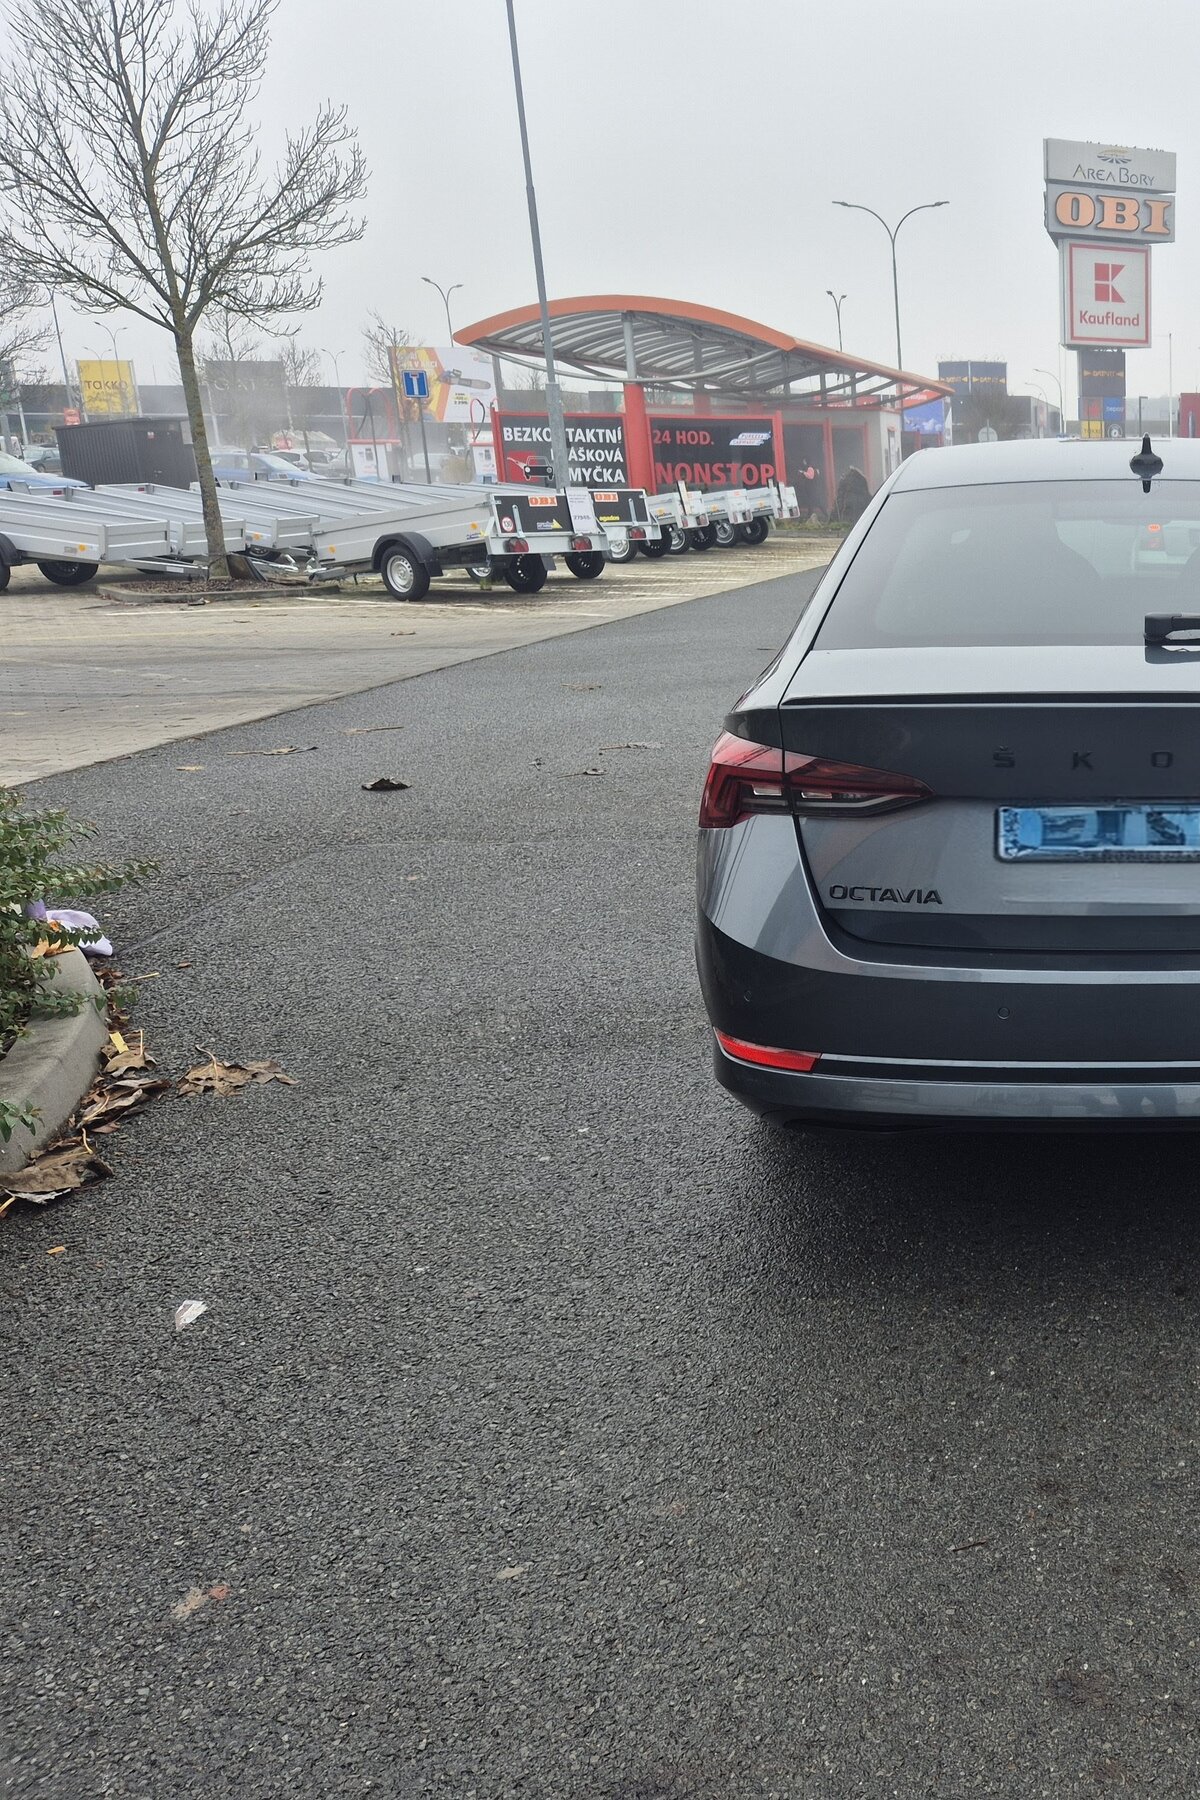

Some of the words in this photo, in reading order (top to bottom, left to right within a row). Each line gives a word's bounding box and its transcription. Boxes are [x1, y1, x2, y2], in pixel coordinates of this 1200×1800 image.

[1072, 164, 1116, 182] AREA
[1119, 167, 1155, 186] BORY
[1055, 191, 1171, 235] OBI
[1079, 310, 1140, 327] Kaufland
[503, 426, 622, 443] BEZKOTAKTNÍ
[653, 430, 671, 444] 24
[676, 430, 715, 445] HOD.
[550, 447, 624, 462] ÁŠKOVÁ
[568, 466, 625, 483] MYČKA
[655, 463, 775, 486] NONSTOP
[829, 884, 942, 905] OCTAVIA
